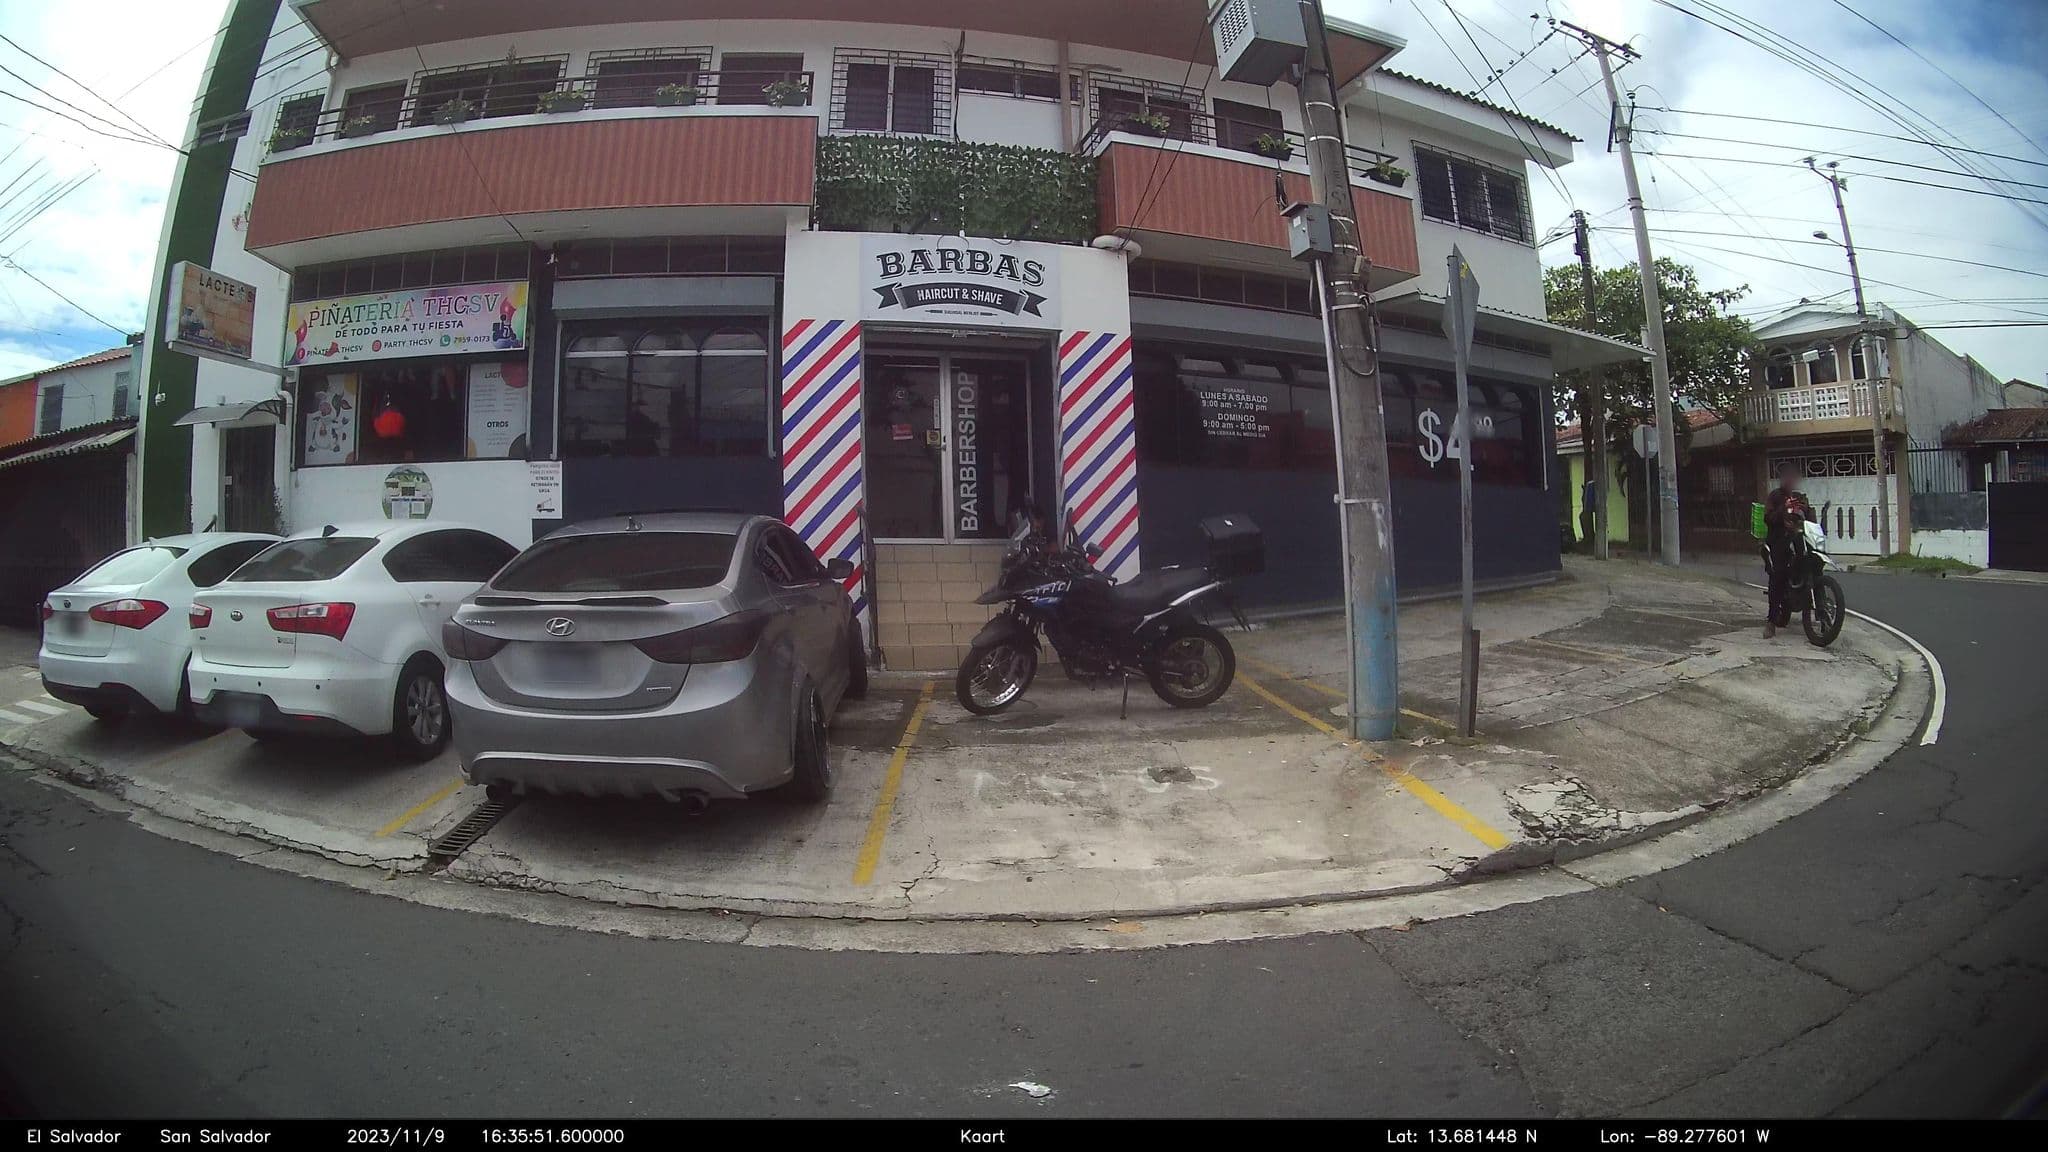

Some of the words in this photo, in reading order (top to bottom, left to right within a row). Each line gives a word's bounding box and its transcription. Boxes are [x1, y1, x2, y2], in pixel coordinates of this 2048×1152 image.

[876, 248, 1046, 287] BARBAS
[916, 287, 960, 301] HAIRCUT
[961, 288, 969, 300] &
[971, 289, 1003, 305] SHAVE
[423, 293, 500, 317] THCSV
[335, 329, 349, 339] DE
[351, 325, 378, 337] TODO
[380, 324, 408, 334] PARA
[412, 322, 426, 332] TU
[428, 320, 464, 330] FIESTA
[384, 340, 406, 349] PARTY
[409, 338, 434, 347] THCSV
[306, 347, 340, 357] PIÑATE
[1200, 391, 1227, 400] LUNES
[1228, 393, 1235, 401] A
[1235, 393, 1268, 403] SABADO
[1201, 399, 1218, 408] 9:00
[1217, 413, 1256, 422] DOMINGO
[486, 420, 509, 428] OTROS
[1203, 419, 1220, 428] 9:00
[1257, 424, 1270, 432] pm
[957, 371, 979, 531] BARBERSHOP
